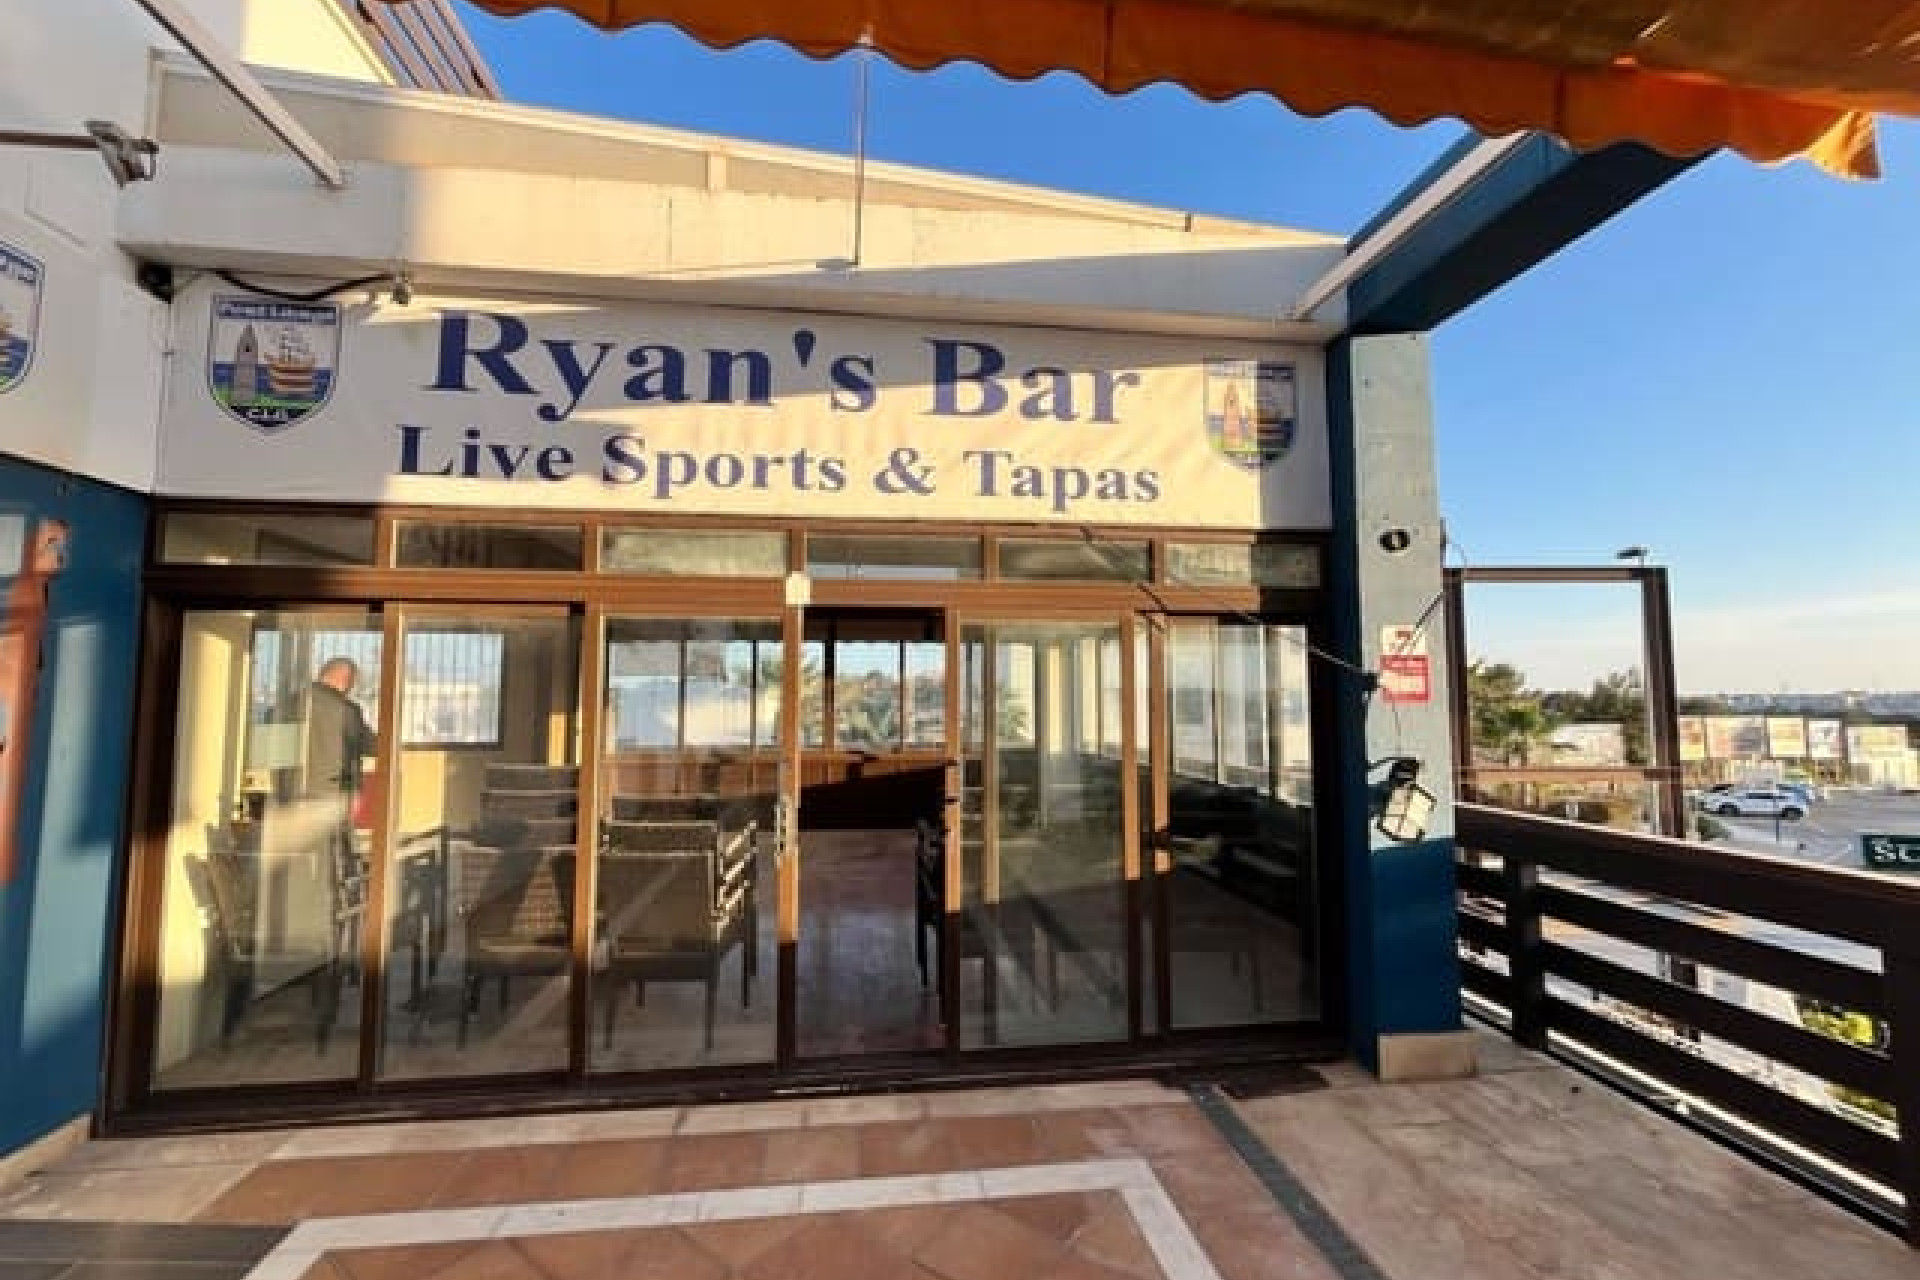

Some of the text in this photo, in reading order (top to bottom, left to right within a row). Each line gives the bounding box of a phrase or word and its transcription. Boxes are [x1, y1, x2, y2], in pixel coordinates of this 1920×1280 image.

[424, 309, 1141, 424] Ryan's Bar
[399, 425, 1160, 512] Live Sports & Tapas
